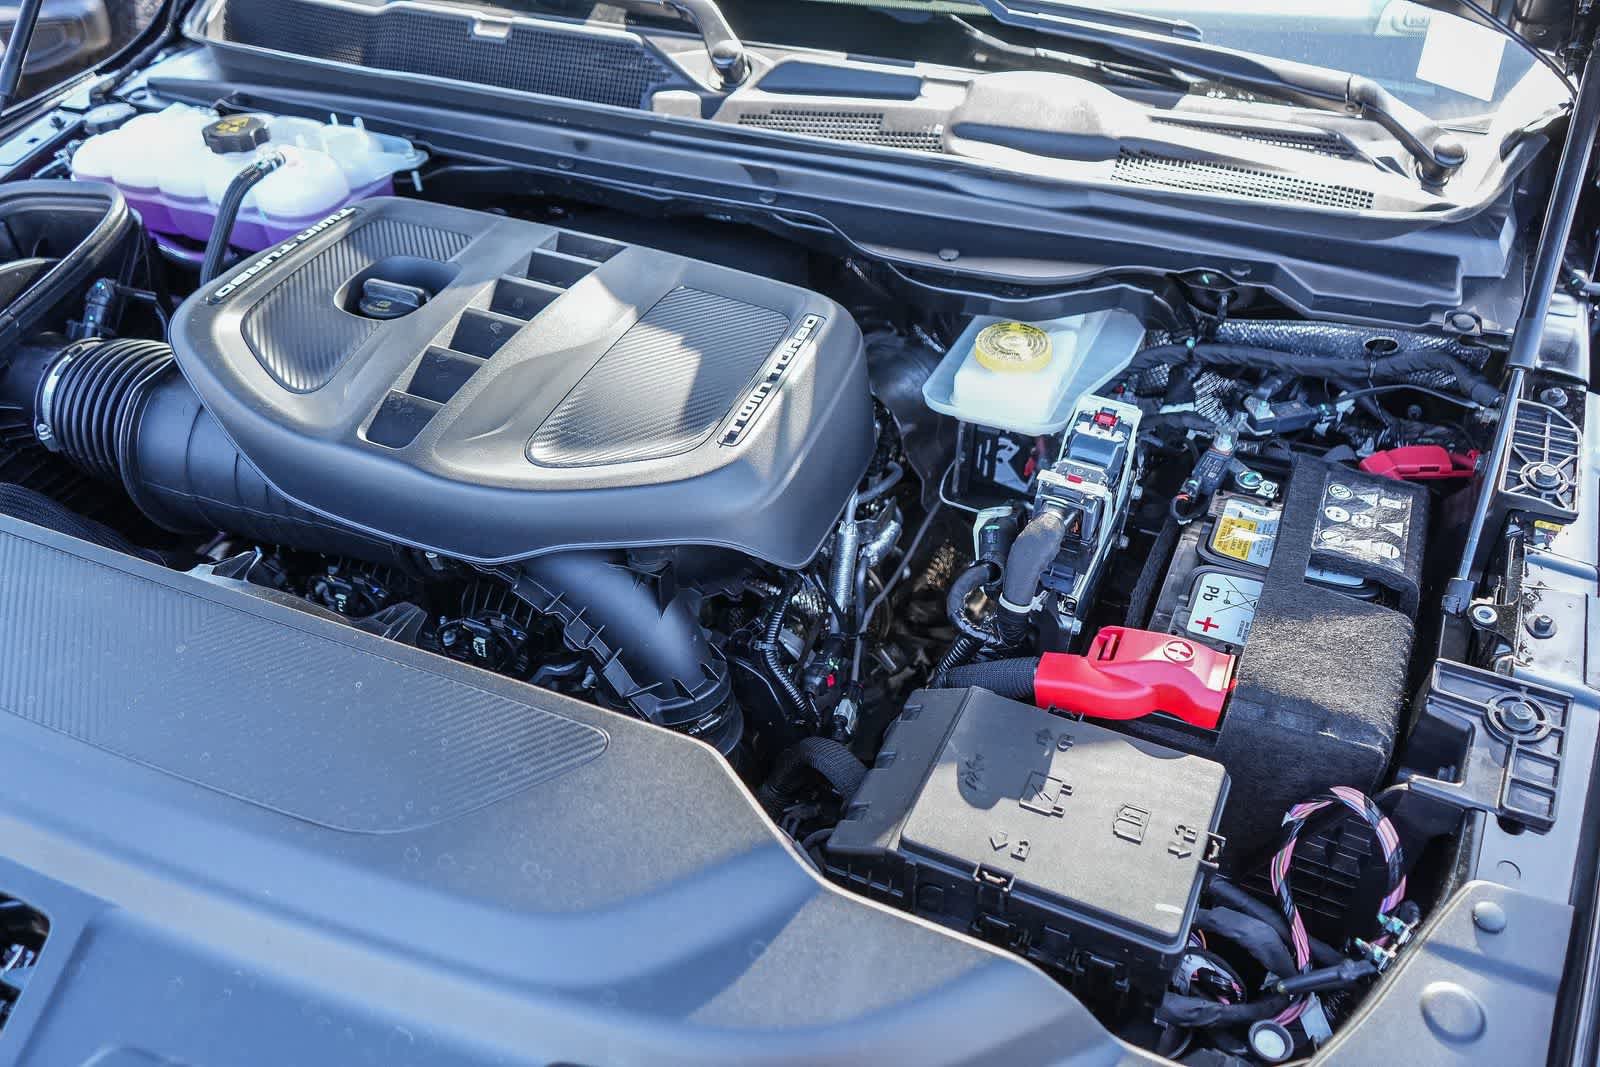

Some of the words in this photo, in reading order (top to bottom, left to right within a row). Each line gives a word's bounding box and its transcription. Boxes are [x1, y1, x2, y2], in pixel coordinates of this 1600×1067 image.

[297, 207, 356, 241] TWIN
[214, 243, 299, 298] TURBO
[719, 382, 773, 446] TWIN
[764, 314, 820, 382] TURBO
[1202, 585, 1220, 601] Pb
